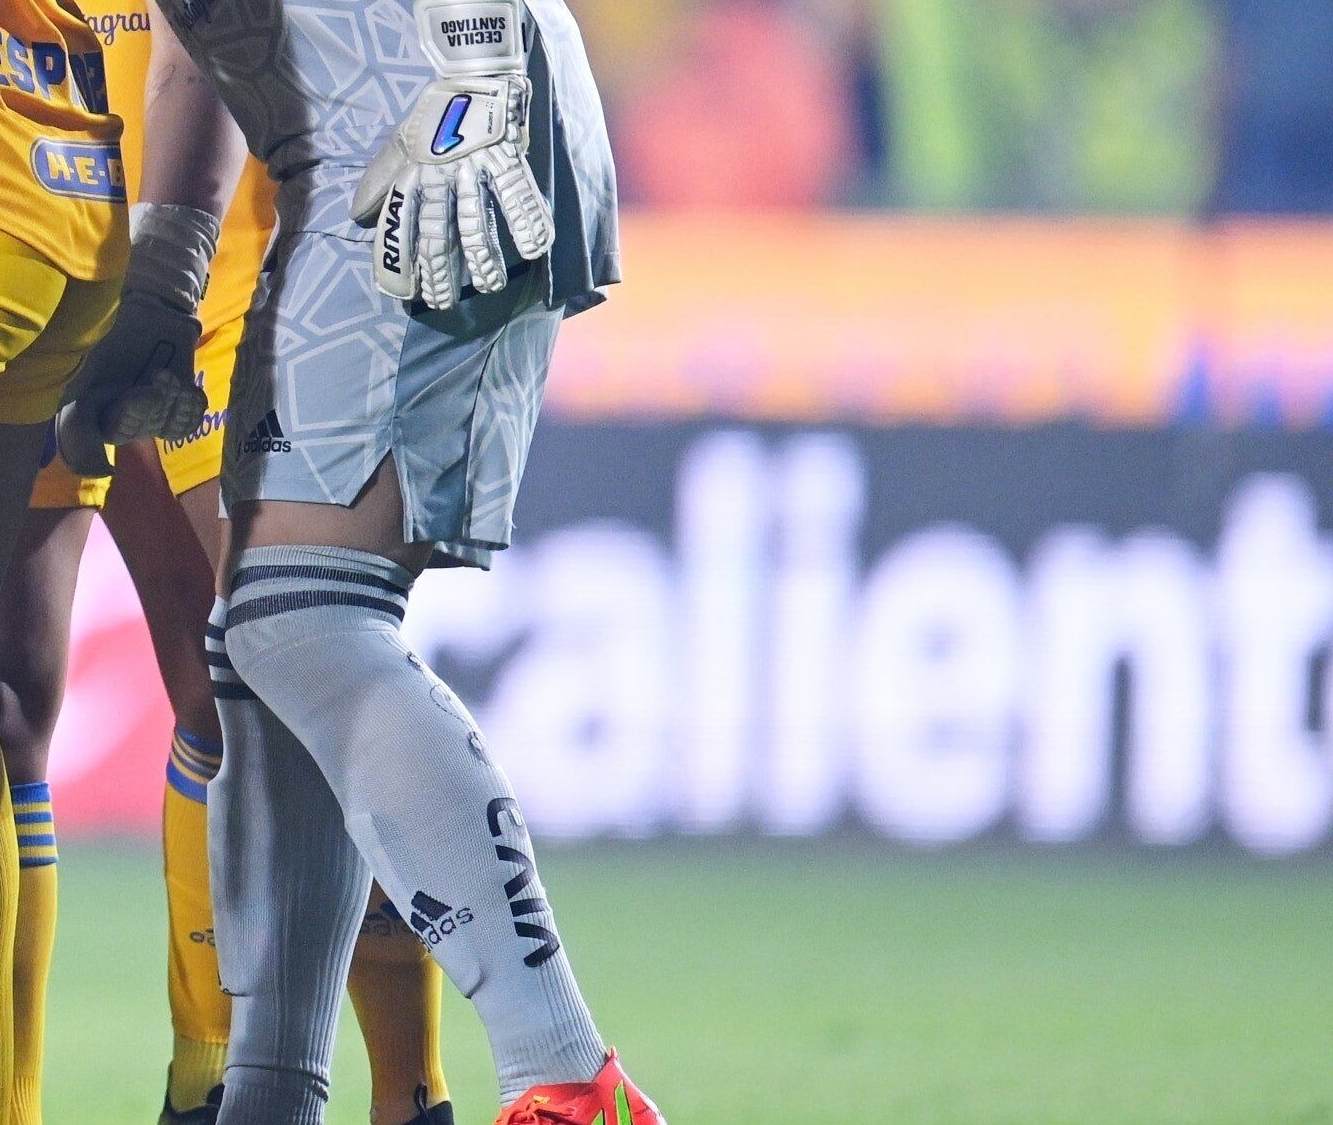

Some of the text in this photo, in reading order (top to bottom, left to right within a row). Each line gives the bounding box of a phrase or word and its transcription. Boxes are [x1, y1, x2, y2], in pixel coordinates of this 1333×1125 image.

[440, 17, 506, 34] SANTIAGO
[447, 30, 503, 47] CECILIA
[383, 188, 406, 274] RINAT
